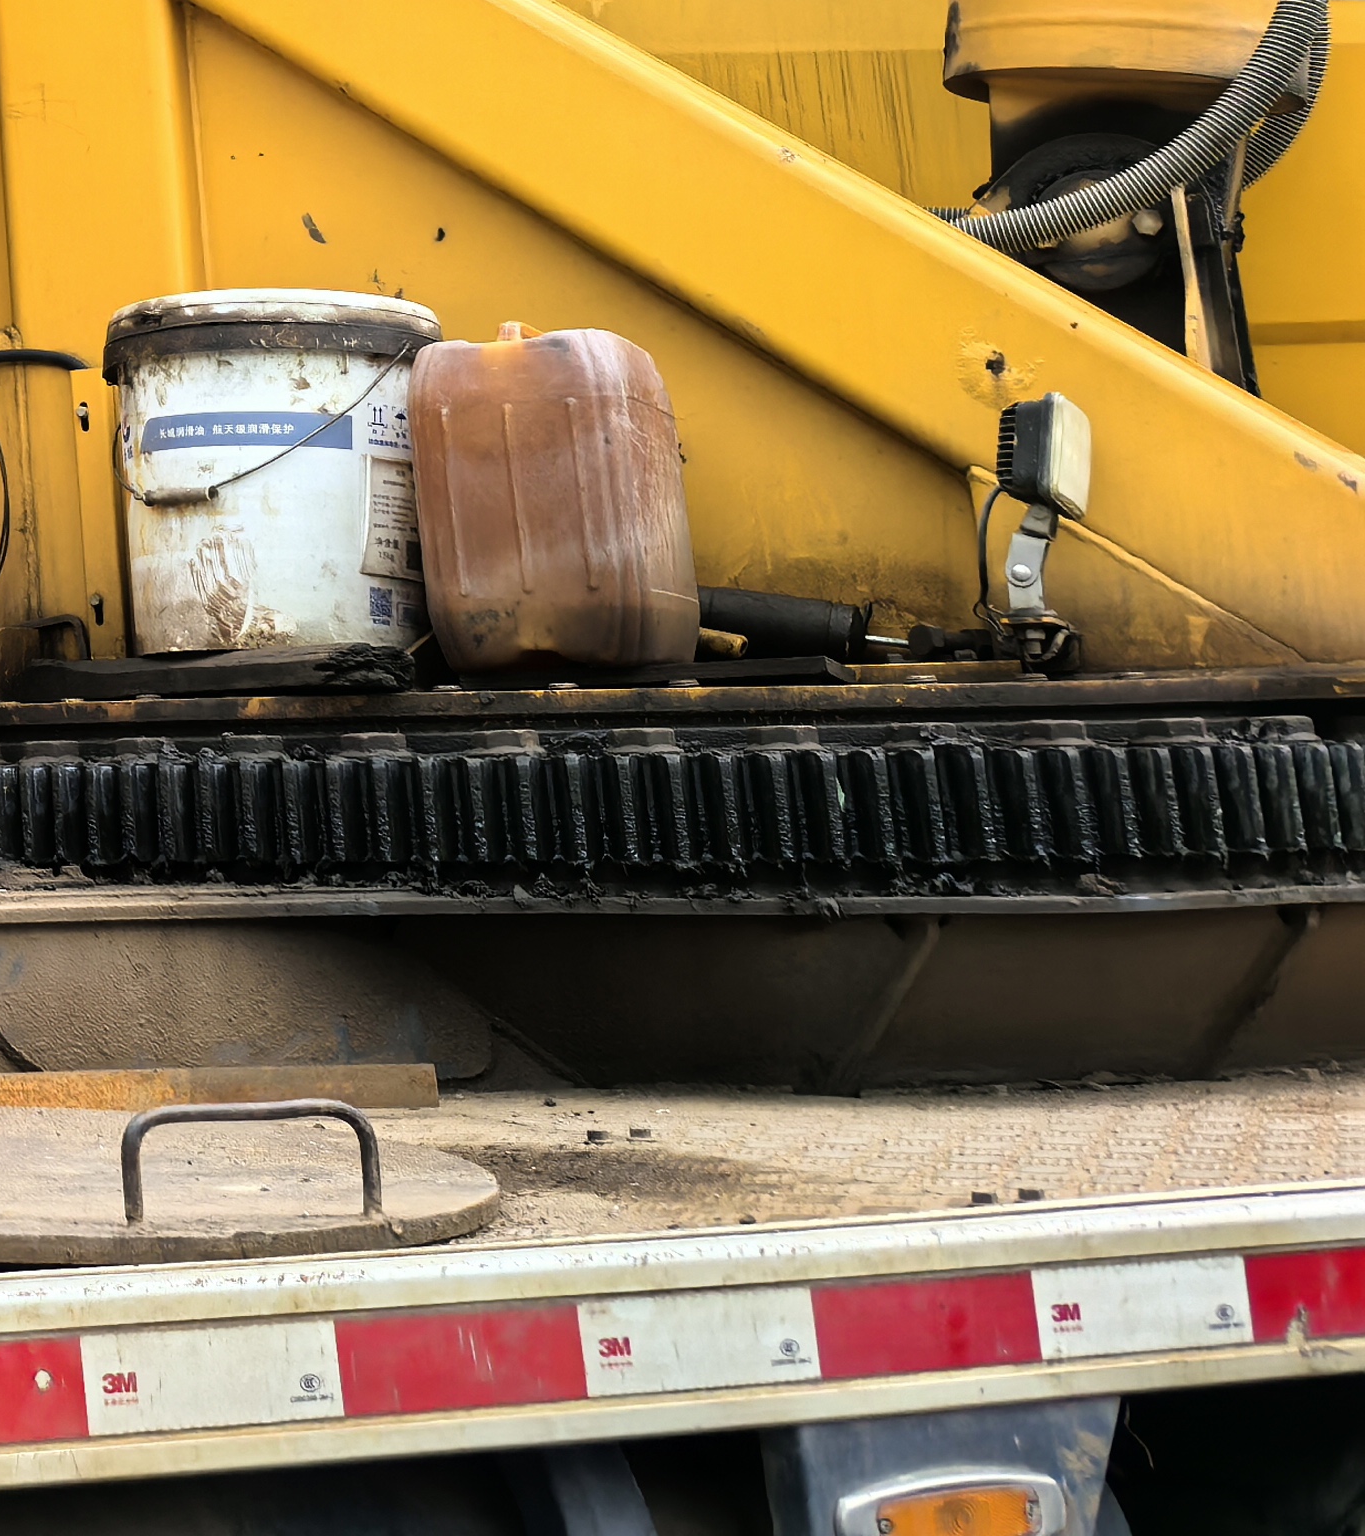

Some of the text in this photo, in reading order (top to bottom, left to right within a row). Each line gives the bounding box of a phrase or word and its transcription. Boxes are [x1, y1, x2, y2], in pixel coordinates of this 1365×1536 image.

[212, 423, 294, 436] 航天级润滑保护
[1051, 1303, 1081, 1322] 3M
[599, 1336, 631, 1357] 3M
[102, 1372, 138, 1393] 3M
